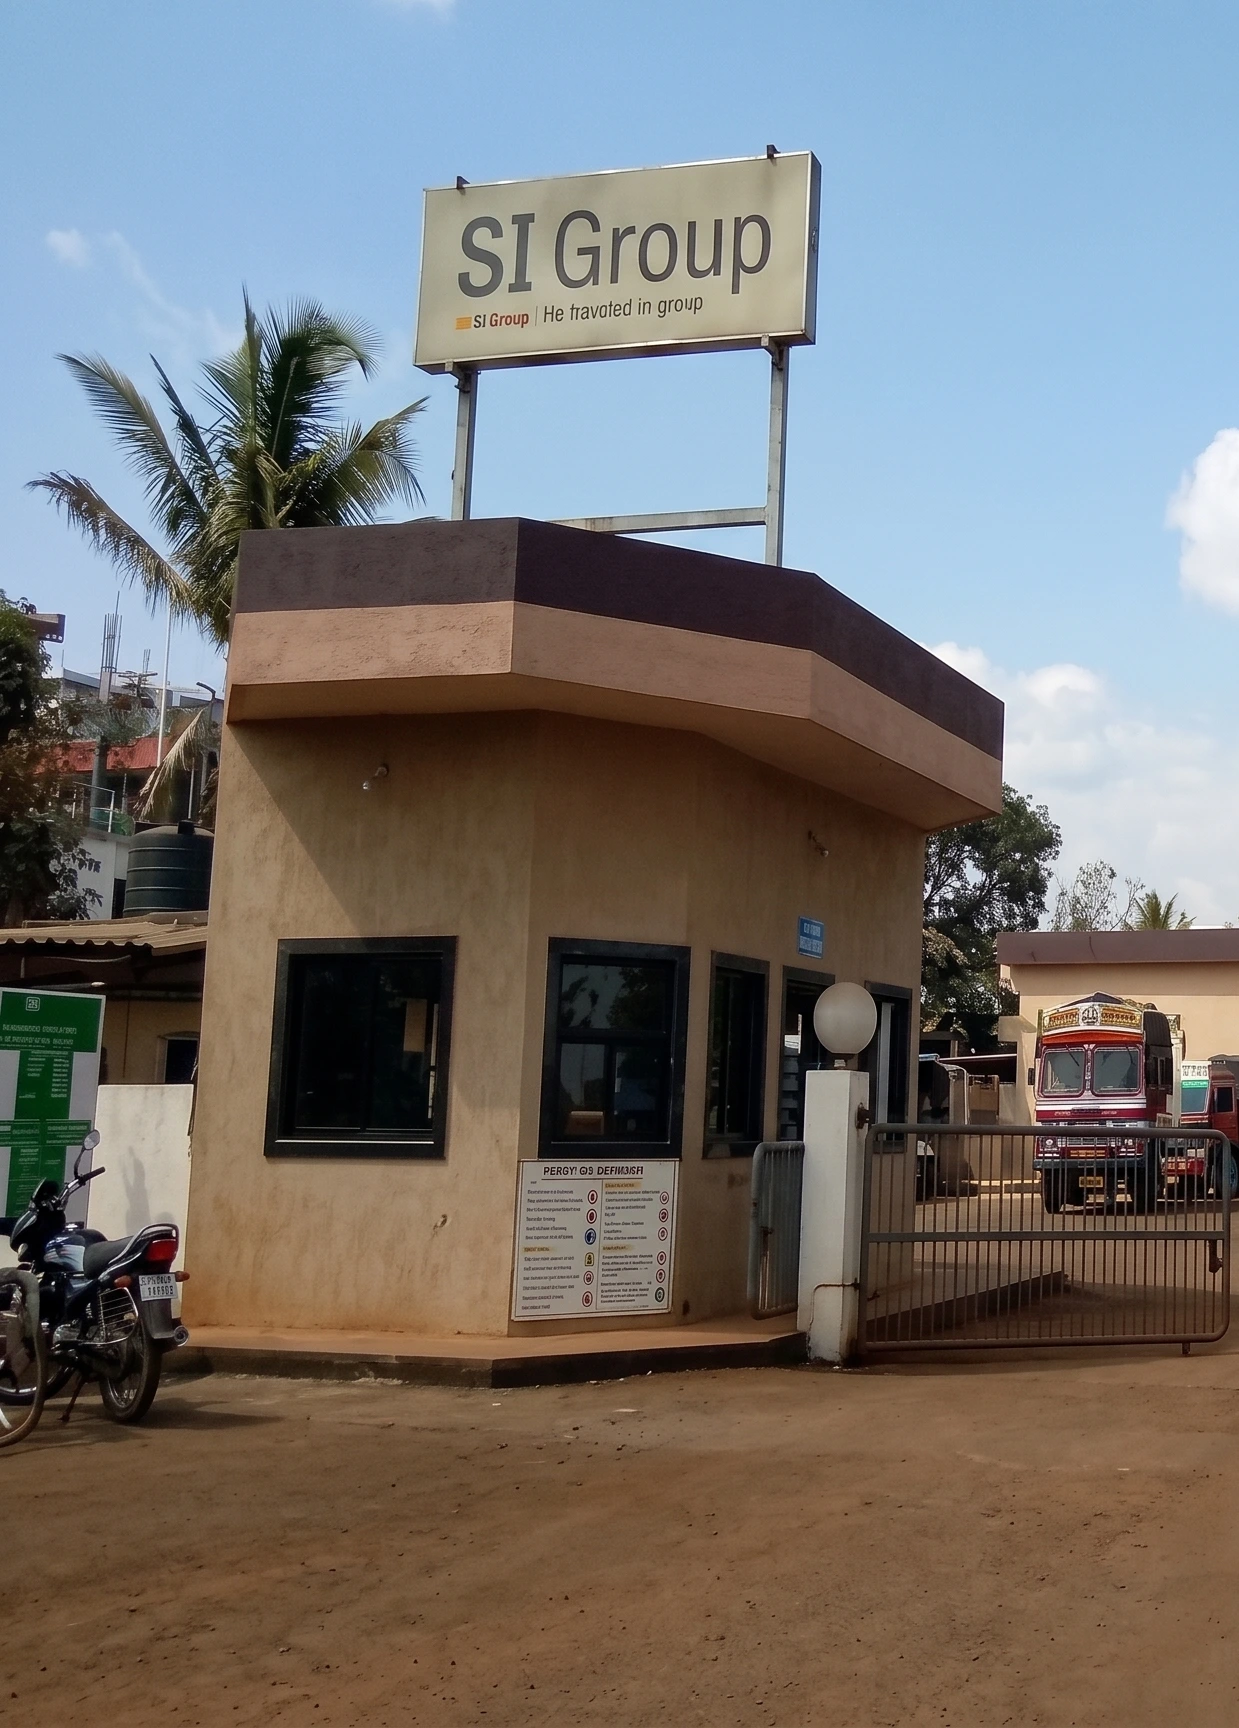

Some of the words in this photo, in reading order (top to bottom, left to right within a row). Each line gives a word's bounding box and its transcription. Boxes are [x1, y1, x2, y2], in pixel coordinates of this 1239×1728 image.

[457, 211, 536, 298] SI
[554, 209, 773, 295] Group
[473, 314, 486, 329] SI
[489, 312, 530, 328] Group
[543, 305, 564, 323] He
[638, 297, 652, 315] in
